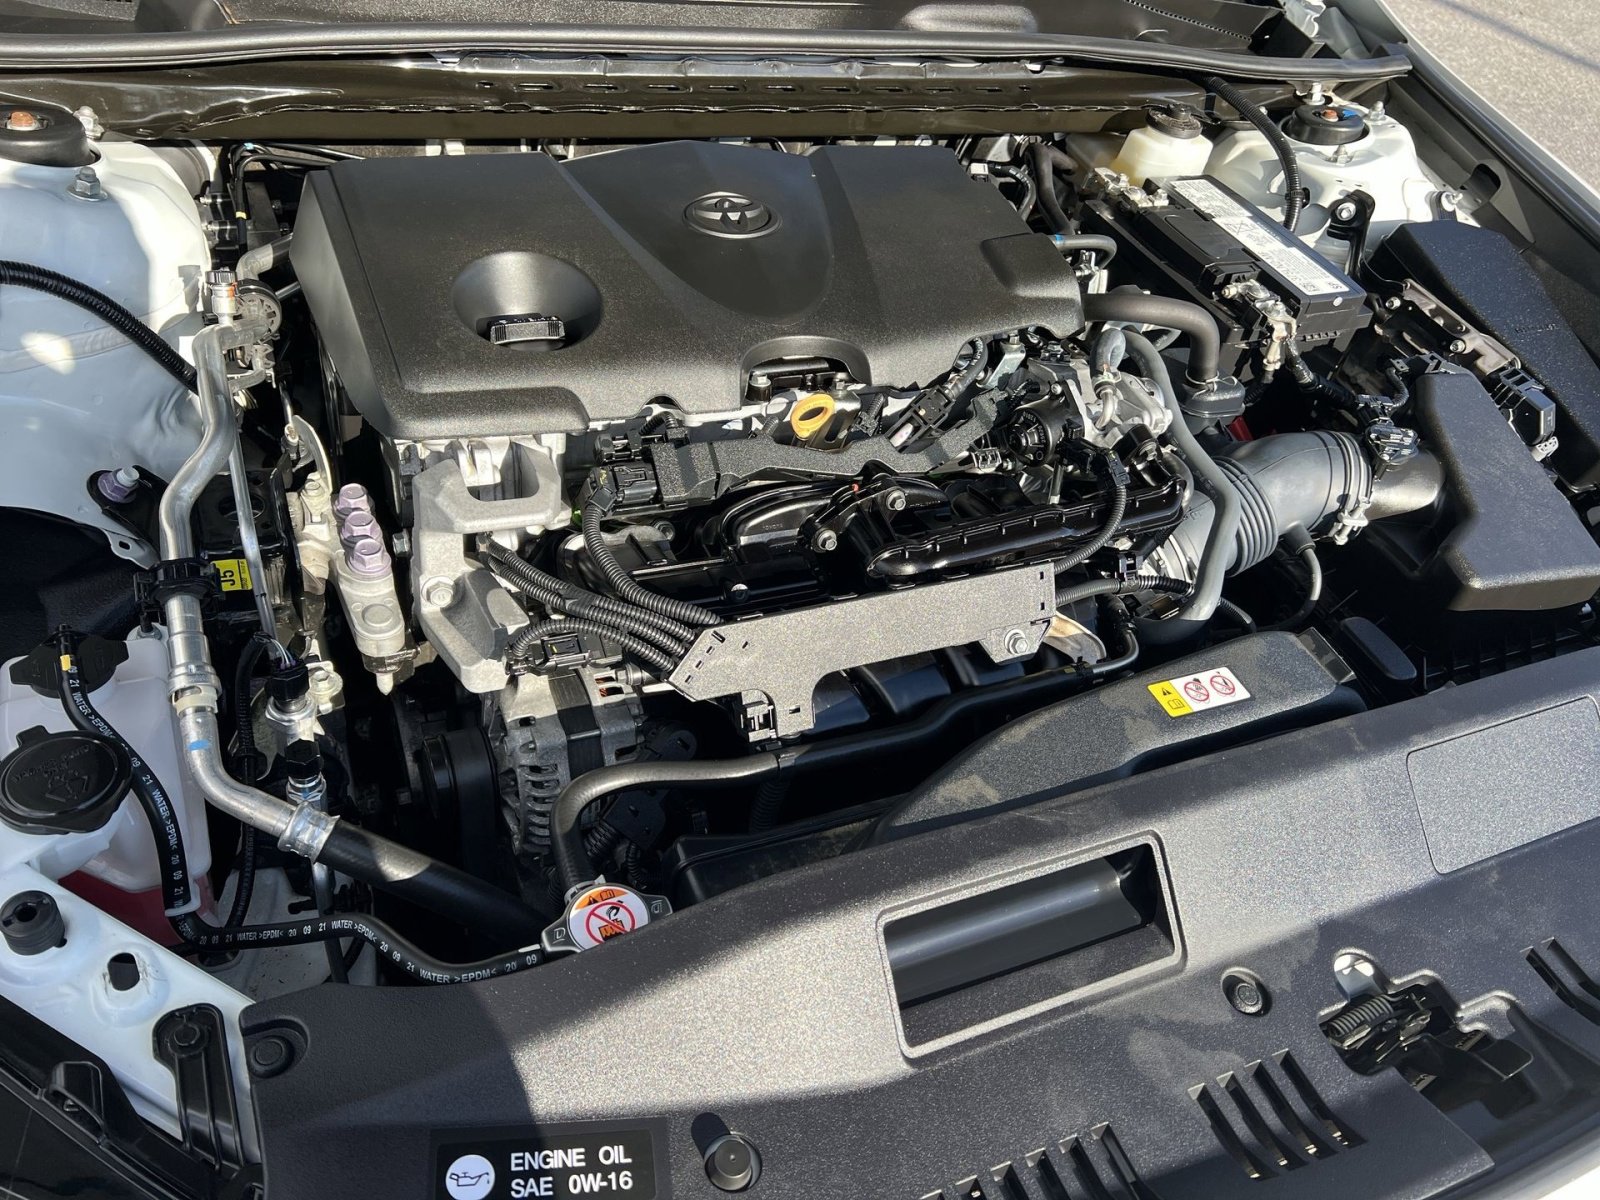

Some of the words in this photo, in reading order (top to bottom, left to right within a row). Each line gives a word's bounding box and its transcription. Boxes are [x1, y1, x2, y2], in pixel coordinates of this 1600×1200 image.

[220, 569, 236, 586] J5
[69, 679, 80, 688] 21
[72, 691, 92, 715] WATER
[131, 757, 141, 768] 09
[142, 774, 153, 785] 21
[152, 788, 170, 819] WATER
[165, 819, 178, 850] >EPDM<
[170, 854, 180, 865] 20
[173, 870, 183, 880] 09
[174, 886, 184, 896] 21
[225, 934, 233, 943] 21
[236, 932, 258, 941] WATER
[258, 929, 284, 940] >EPDM<
[288, 928, 297, 937] 20
[302, 925, 312, 935] 09
[318, 922, 327, 932] 21
[331, 919, 354, 929] WATER
[353, 923, 378, 942] >EPDM<
[379, 941, 389, 952] 20
[392, 950, 401, 962] 09
[406, 961, 415, 972] 21
[419, 967, 451, 984] WATER
[453, 967, 497, 983] >EPDM<
[504, 960, 517, 973] 20
[525, 953, 537, 966] 09
[510, 1147, 586, 1172] ENGINE
[598, 1144, 633, 1166] OIL
[510, 1176, 554, 1199] SAE
[568, 1170, 634, 1195] 0W-16
